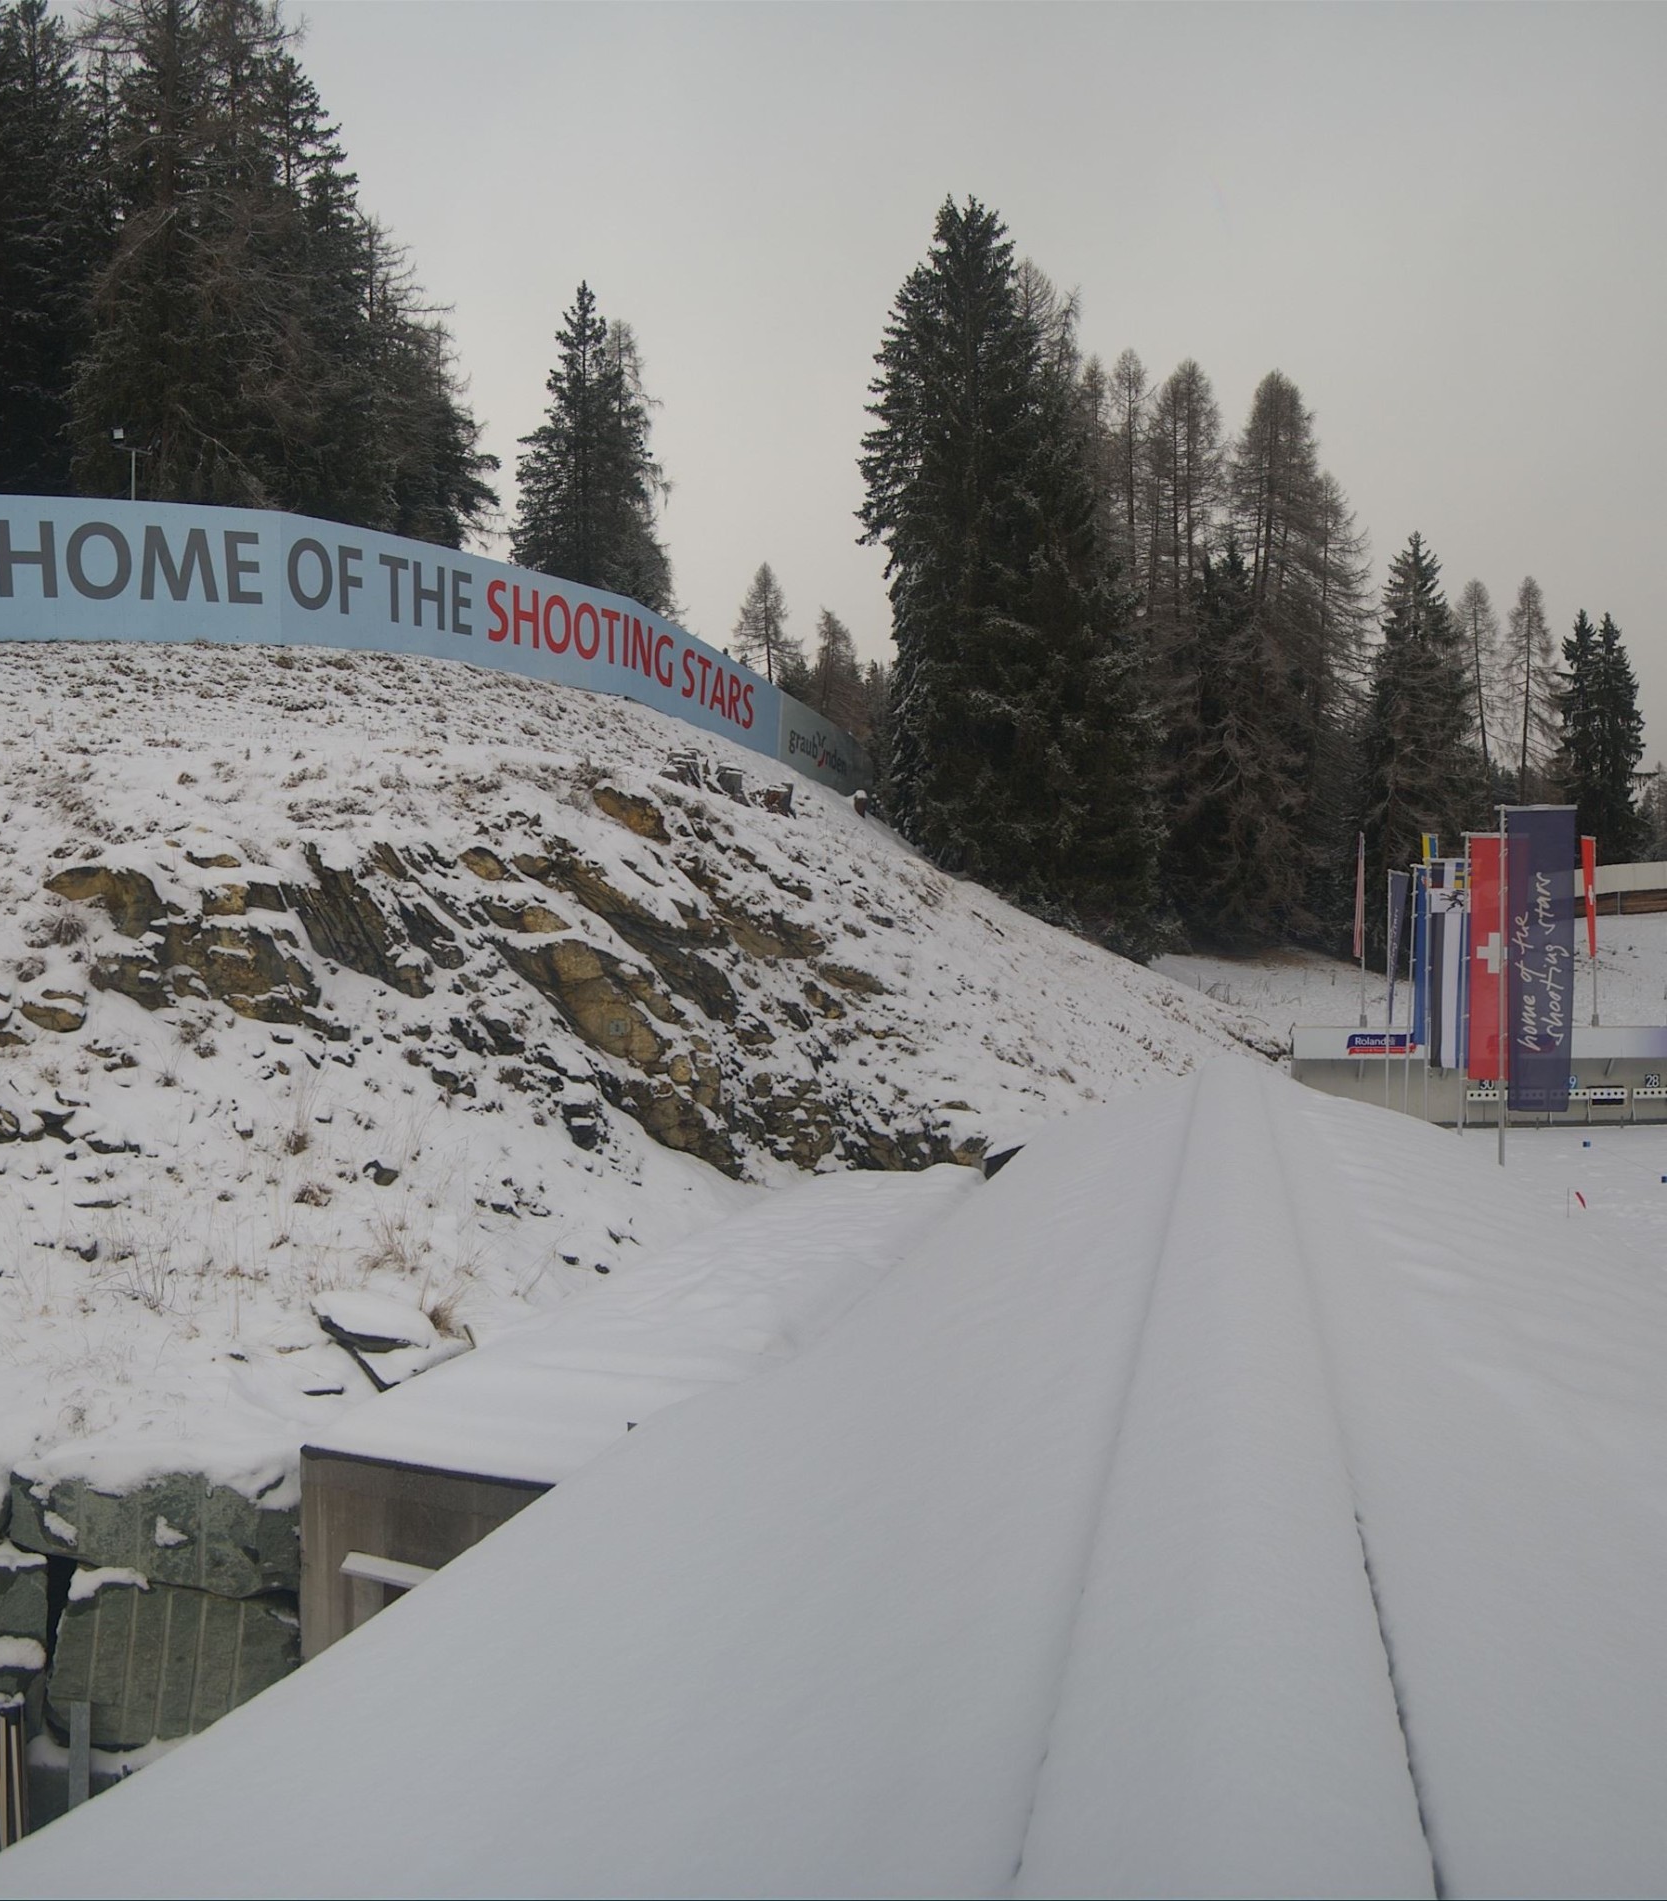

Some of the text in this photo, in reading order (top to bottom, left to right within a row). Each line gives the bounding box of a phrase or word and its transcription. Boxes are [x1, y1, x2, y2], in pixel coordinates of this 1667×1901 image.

[287, 537, 363, 615] OF
[379, 553, 473, 636] THE
[486, 579, 674, 688] SHOOTING
[681, 648, 755, 730] STARS
[1515, 959, 1540, 983] of
[1539, 943, 1571, 1047] shooting
[1355, 1036, 1386, 1046] Roland
[1516, 994, 1542, 1052] home
[1645, 1075, 1659, 1087] 28
